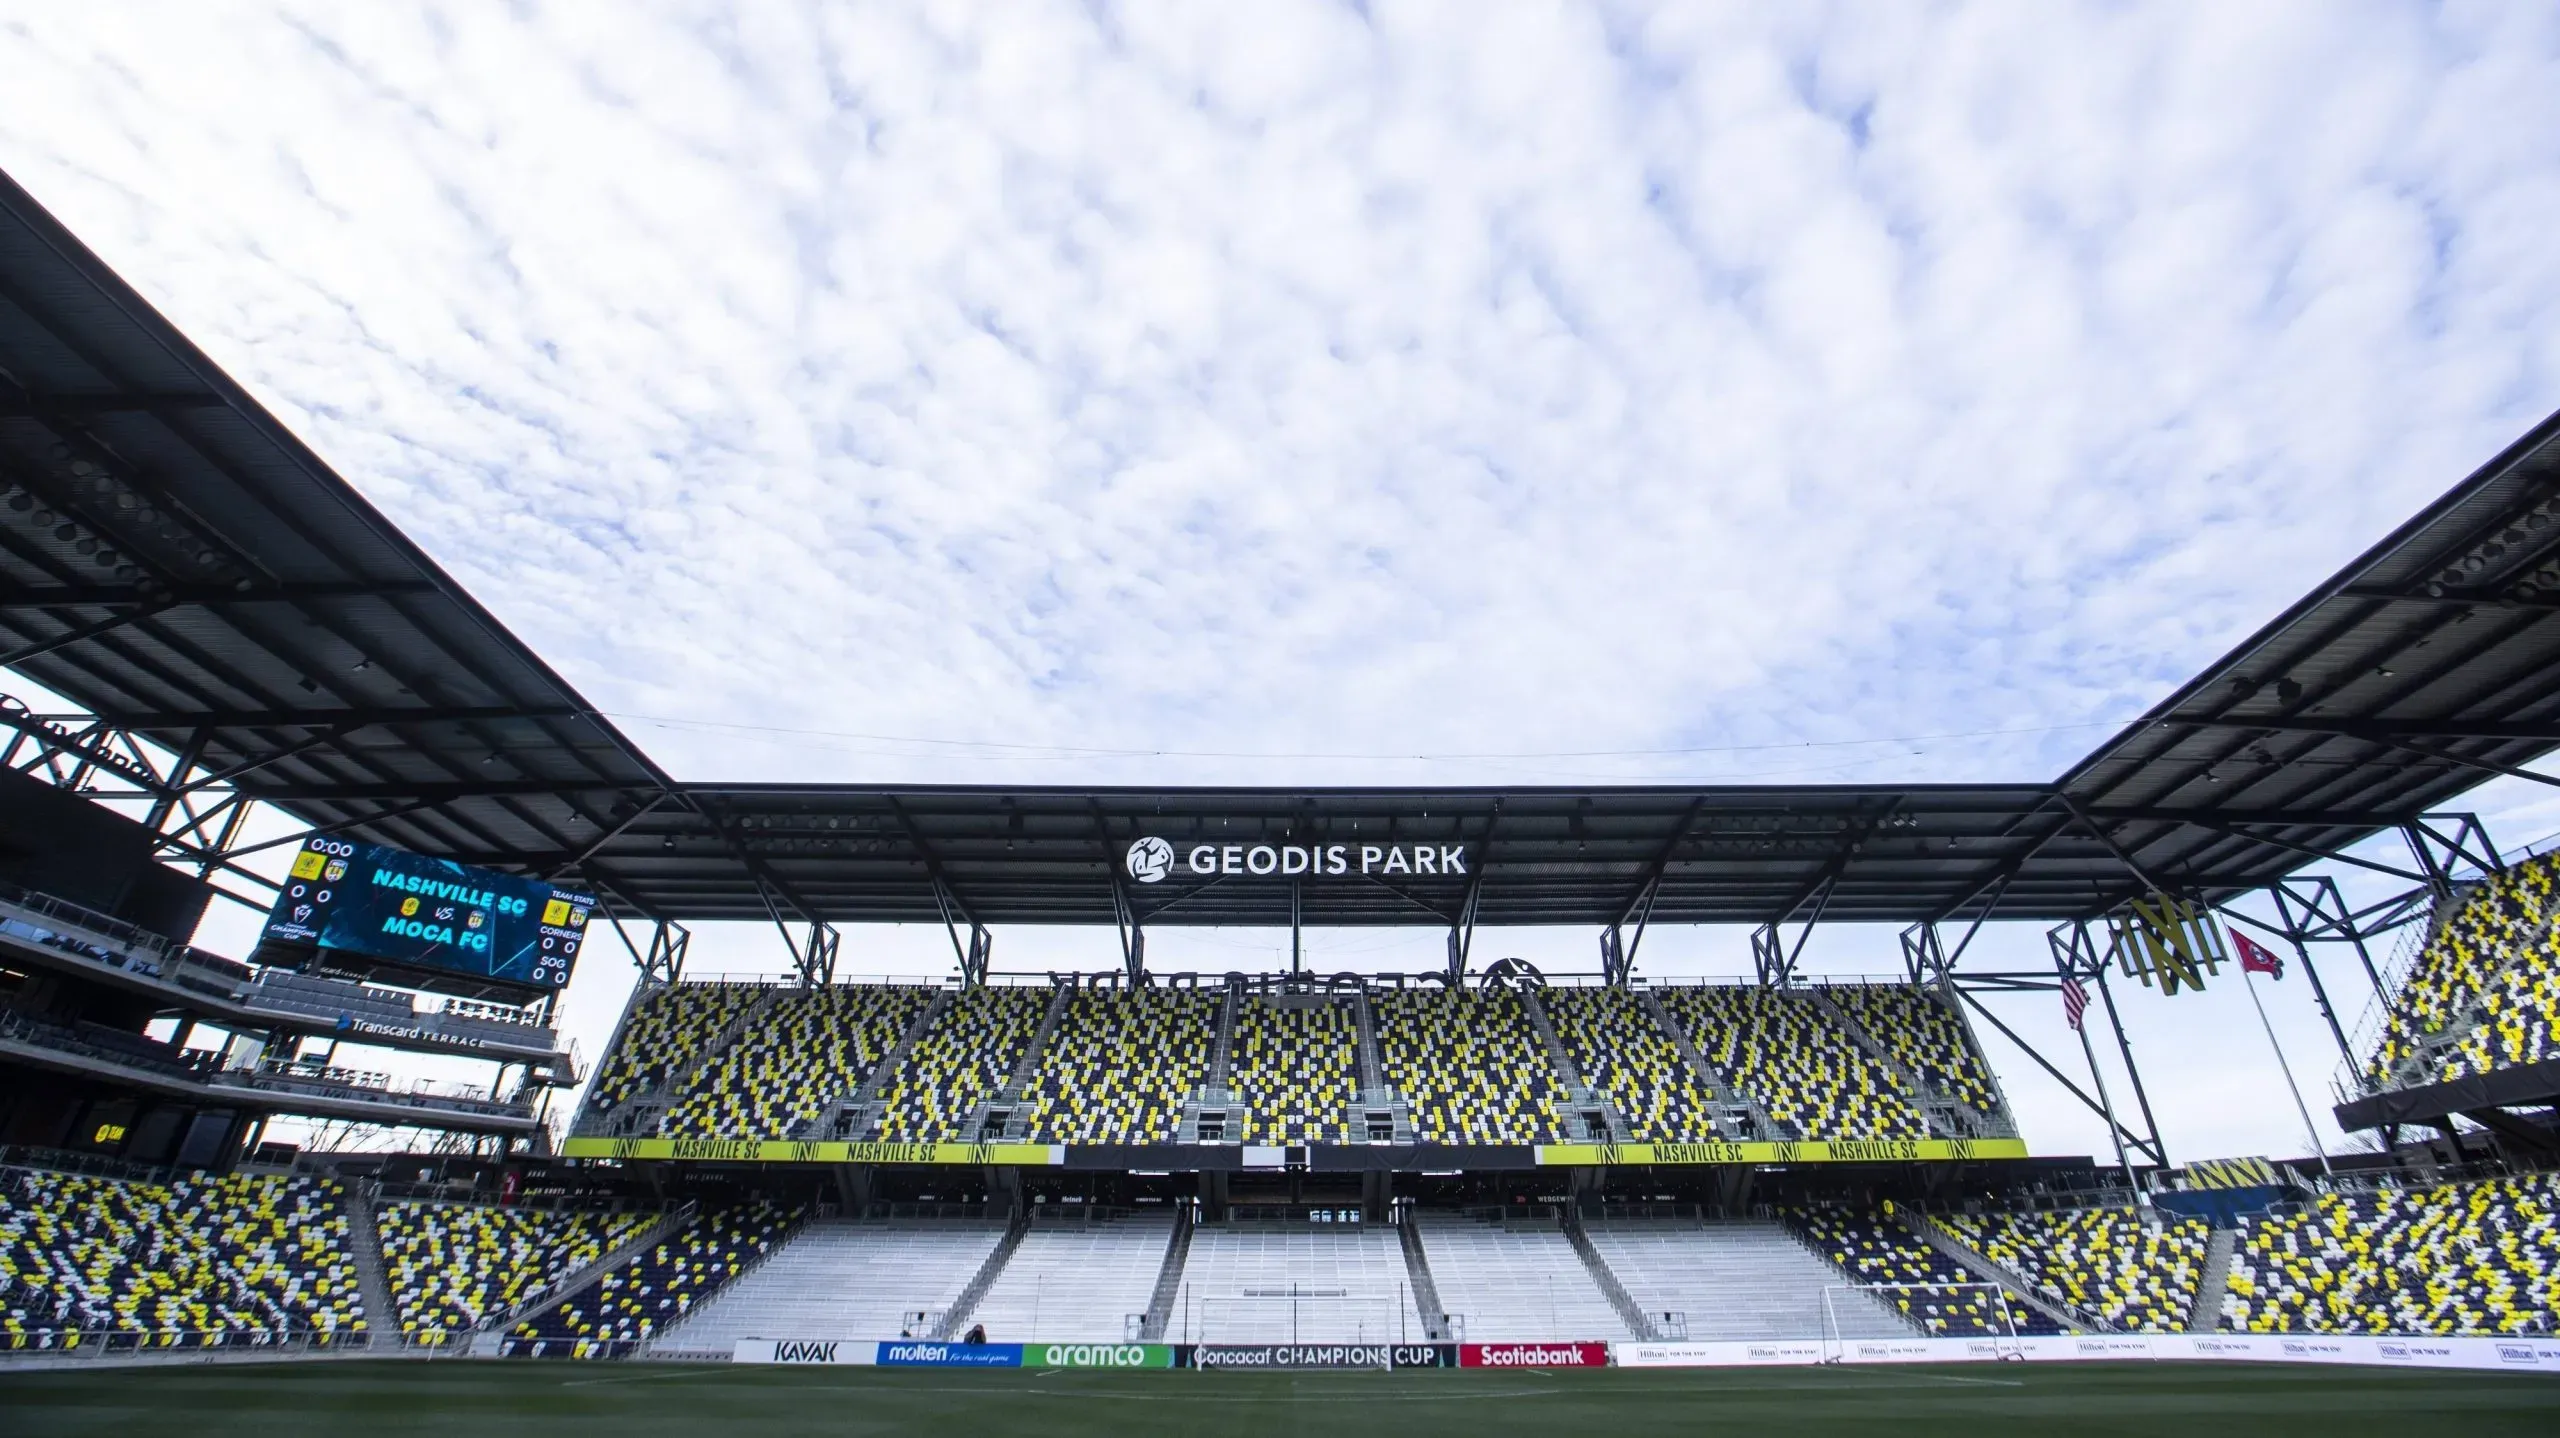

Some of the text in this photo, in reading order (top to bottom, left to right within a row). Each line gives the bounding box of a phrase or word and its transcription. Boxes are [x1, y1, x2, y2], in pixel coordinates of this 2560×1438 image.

[311, 838, 353, 857] 0:00
[1189, 846, 1466, 874] GEODIS PARK
[291, 885, 331, 903] 0 0
[372, 869, 528, 914] NASHVILLE SC
[552, 890, 595, 906] TEAM STATS
[382, 916, 488, 950] MOCA FC
[540, 926, 583, 941] CORNERS
[542, 937, 576, 954] 0 0
[540, 956, 566, 968] SOG
[533, 967, 567, 984] 0 0
[352, 1018, 487, 1048] Transcard TERRACE
[672, 1139, 740, 1159] NASHVILLE
[743, 1140, 762, 1159] SC
[846, 1143, 915, 1162] NASHVILLE
[920, 1144, 937, 1162] SC
[1653, 1145, 1721, 1162] NASHVILLE
[1727, 1144, 1743, 1161] SC
[1828, 1141, 1897, 1160] NASHVILLE
[1901, 1141, 1918, 1159] SC
[774, 1341, 838, 1362] KAVAK
[889, 1344, 947, 1361] molten
[1046, 1345, 1144, 1366] aramco
[1481, 1345, 1584, 1366] Scotiabank
[1640, 1350, 1665, 1358] Hilton
[1750, 1348, 1775, 1357] Hilton
[1861, 1347, 1886, 1355] Hilton
[1970, 1345, 1996, 1353] Hilton
[2080, 1343, 2105, 1351] Hilton
[2380, 1345, 2408, 1355] Hilton
[2501, 1348, 2534, 1359] Hilton
[949, 1353, 1010, 1364] For the real game
[1193, 1347, 1434, 1365] Concacaf CHAMPIONS CUP
